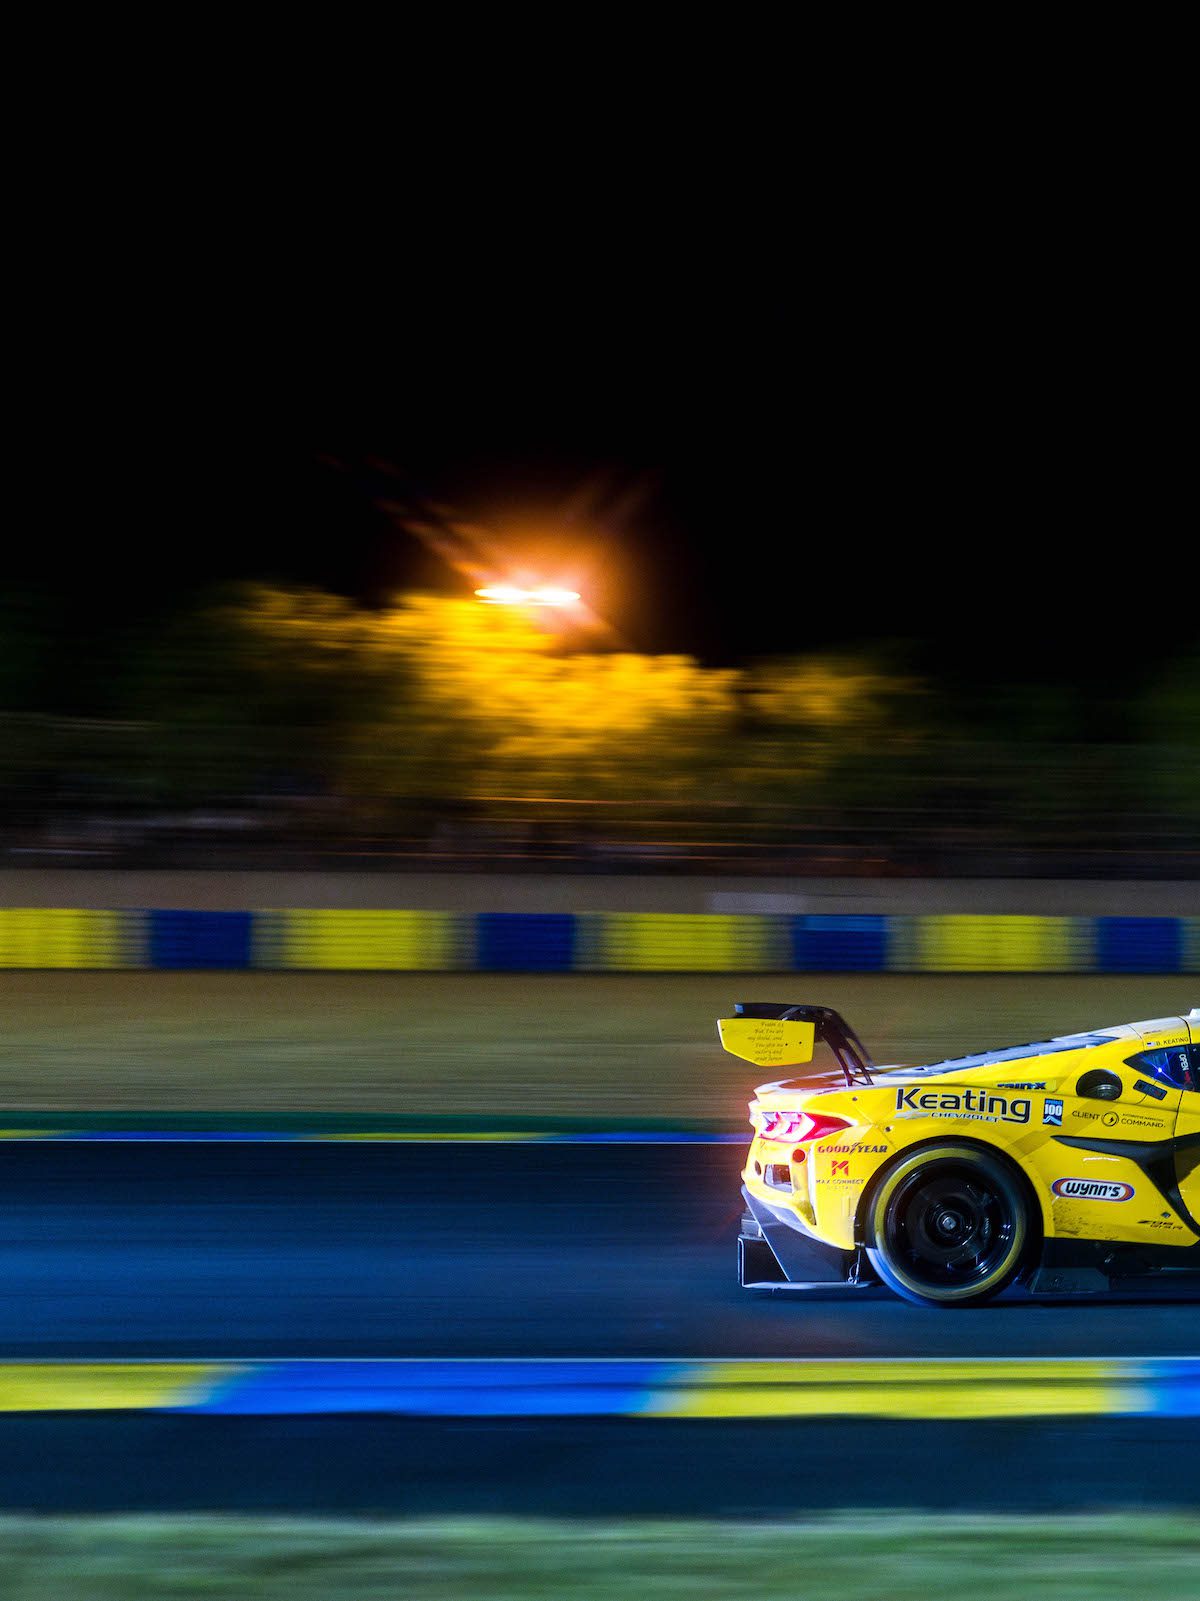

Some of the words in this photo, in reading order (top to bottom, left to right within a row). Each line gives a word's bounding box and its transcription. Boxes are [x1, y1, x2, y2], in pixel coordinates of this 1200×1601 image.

[1163, 1036, 1189, 1045] KEATING
[1179, 1053, 1189, 1071] OPEN
[896, 1088, 1031, 1124] Keating
[1044, 1103, 1063, 1117] 100
[931, 1112, 999, 1123] CHEVROLET
[1072, 1110, 1101, 1121] CLIENT
